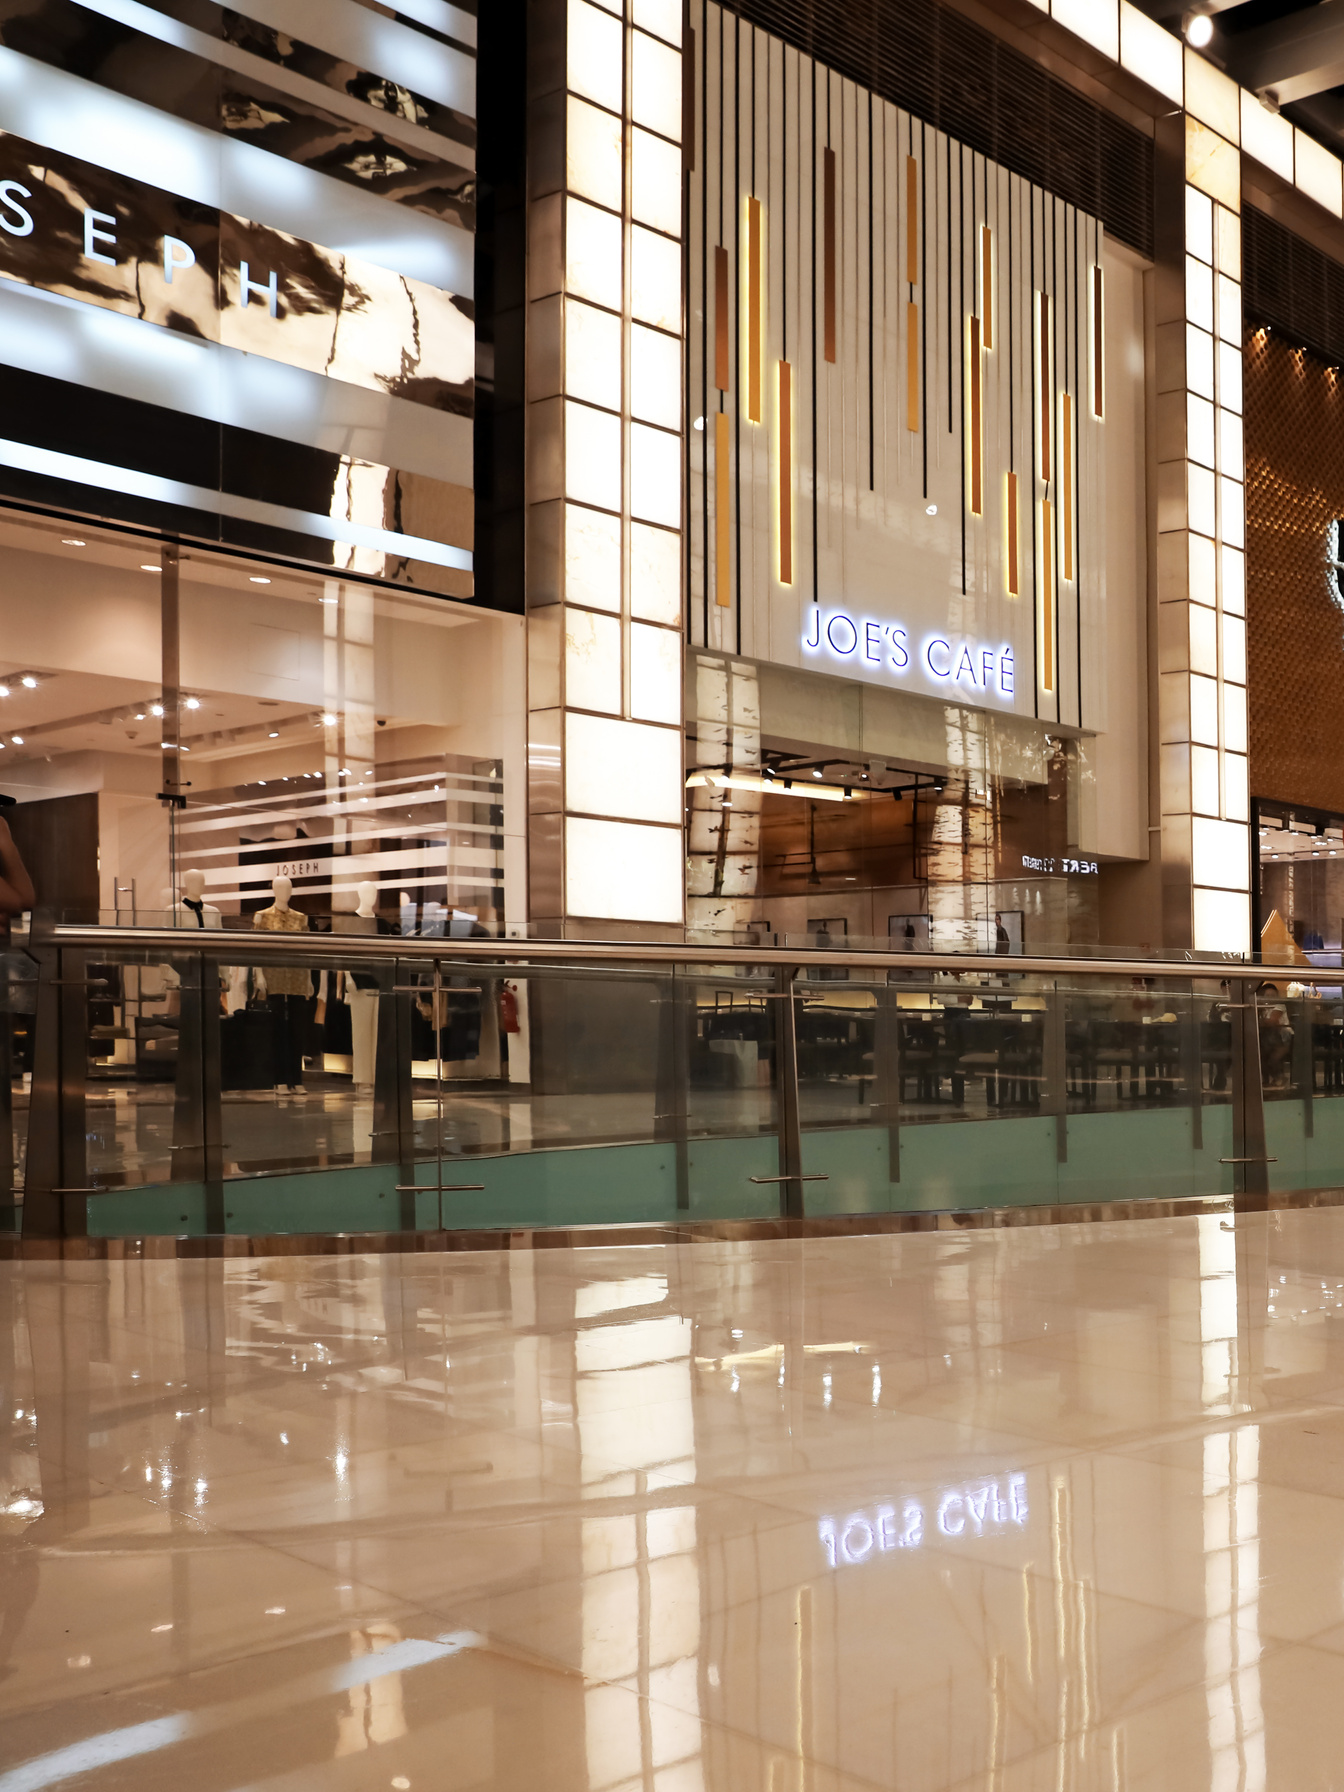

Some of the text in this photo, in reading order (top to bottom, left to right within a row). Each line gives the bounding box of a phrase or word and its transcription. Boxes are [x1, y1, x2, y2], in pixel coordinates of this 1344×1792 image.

[0, 179, 278, 318] SEPH
[806, 609, 1014, 693] JOE'S CAFÉ
[276, 862, 319, 876] JOSEPH
